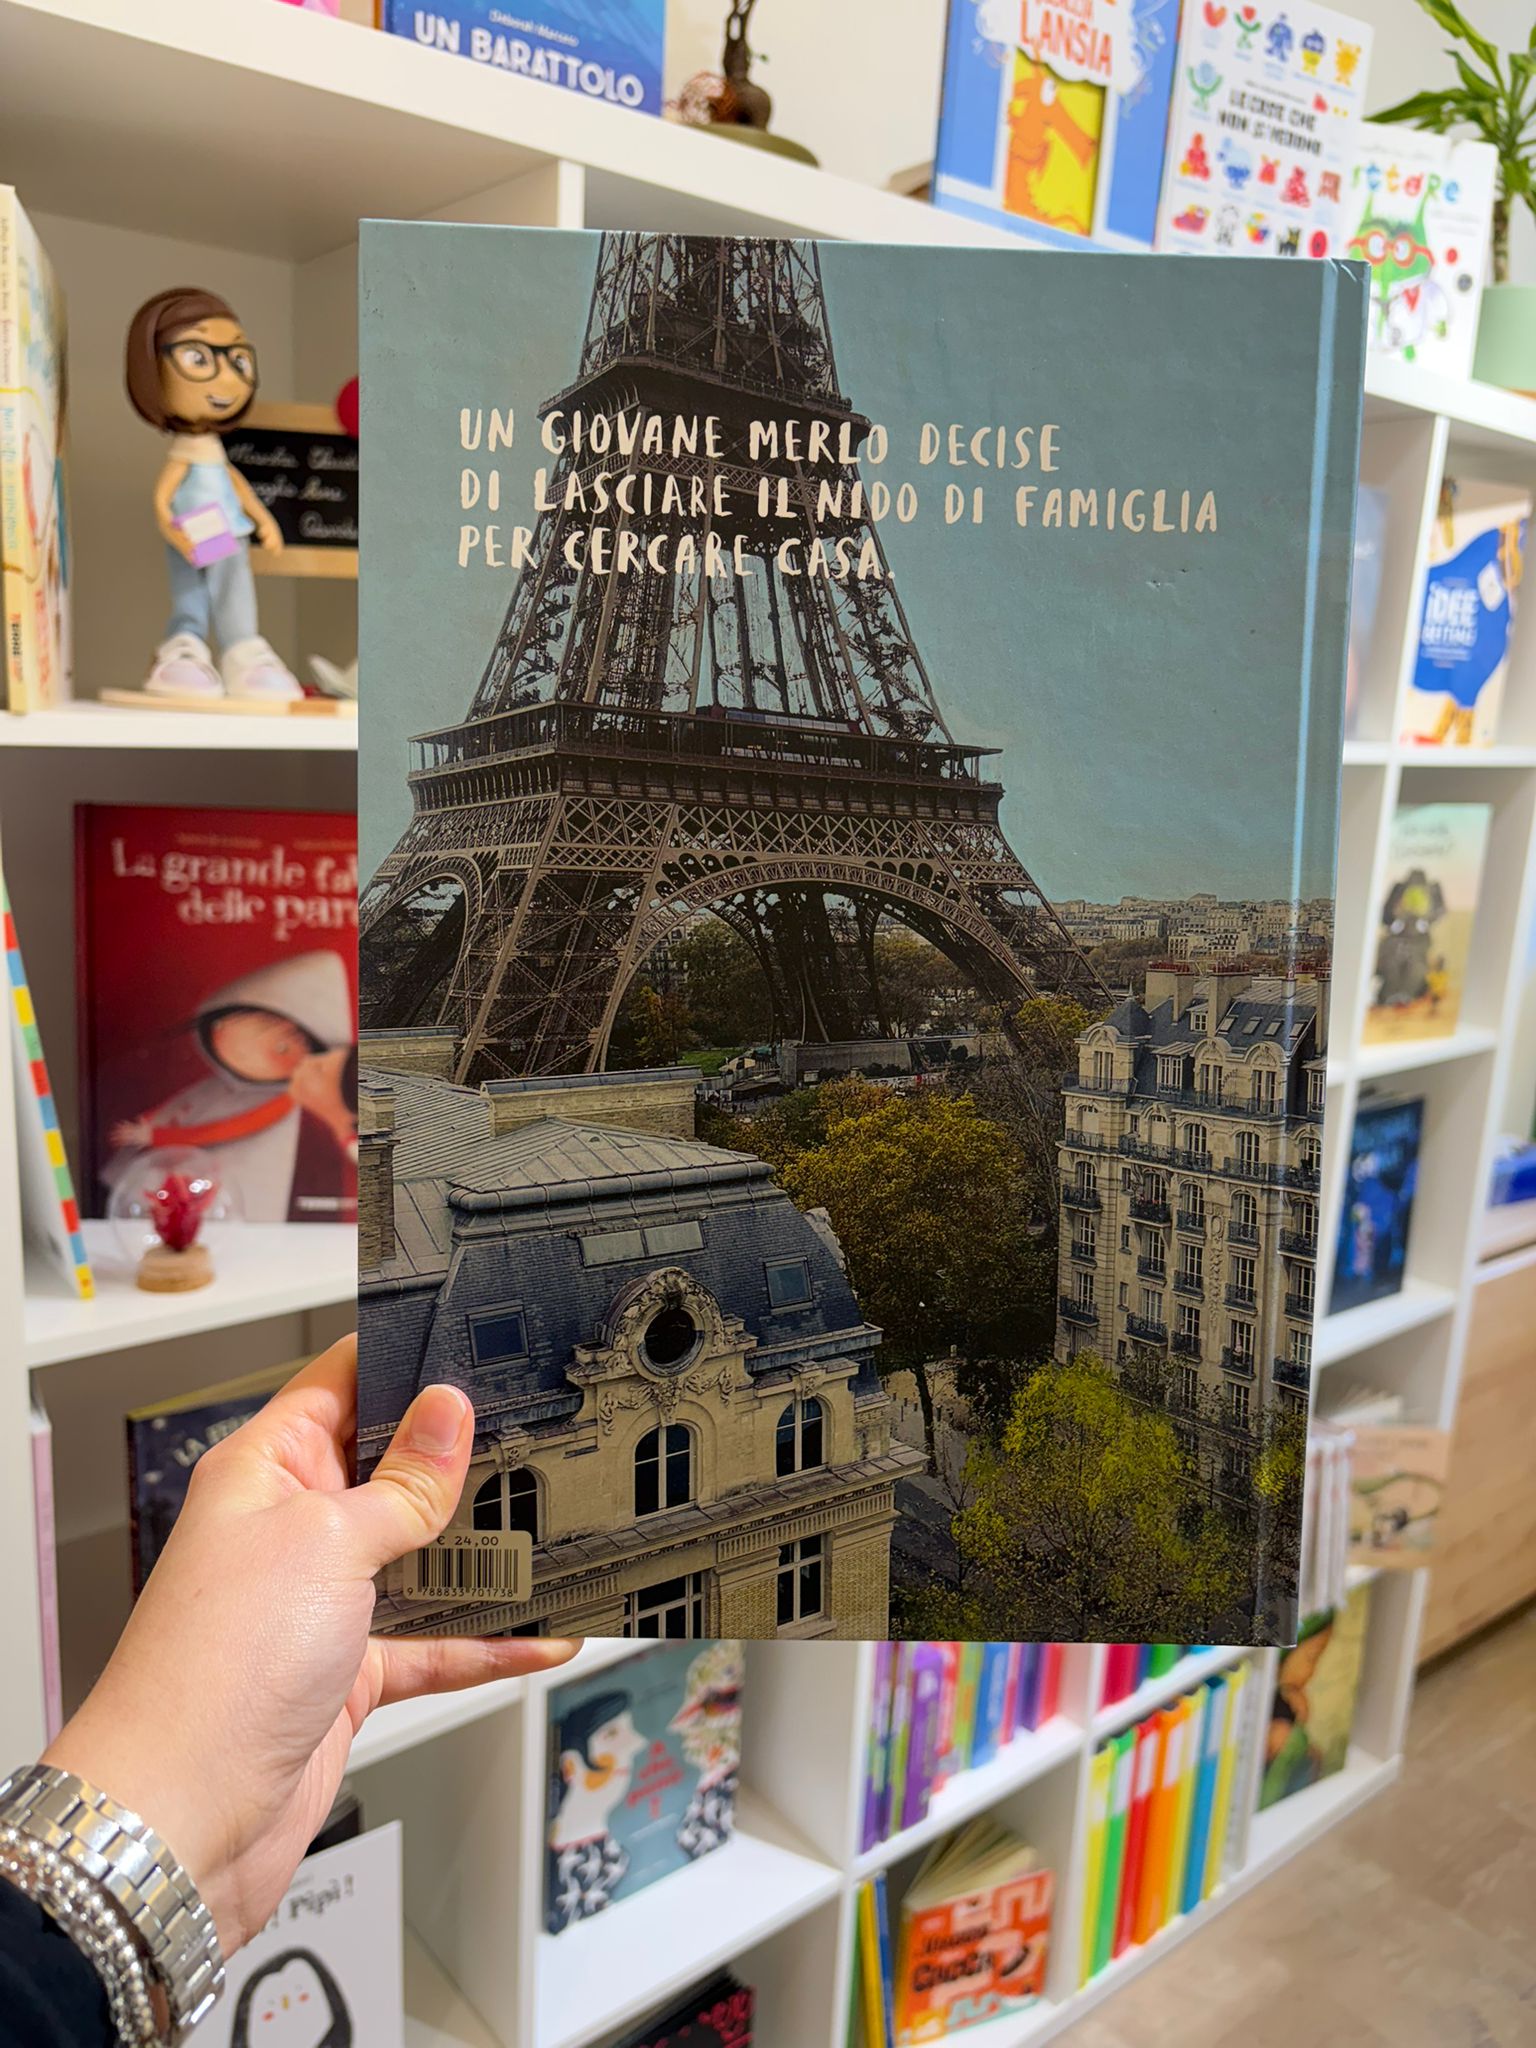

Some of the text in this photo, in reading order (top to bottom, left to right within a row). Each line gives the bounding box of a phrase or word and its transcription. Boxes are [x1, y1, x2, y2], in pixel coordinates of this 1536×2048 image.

[414, 11, 645, 107] UN BARATTOLO
[460, 407, 1061, 472] UN GIOVANE MERLO DECISE
[460, 467, 1218, 533] DI LASCIARE IL NIDO DI FAMIGLIA
[457, 525, 896, 579] PER CERCARE CASA.
[111, 837, 156, 878] La
[161, 844, 306, 894] grande
[177, 886, 266, 926] delle
[454, 1536, 499, 1548] 24,00
[471, 1587, 514, 1598] 701738
